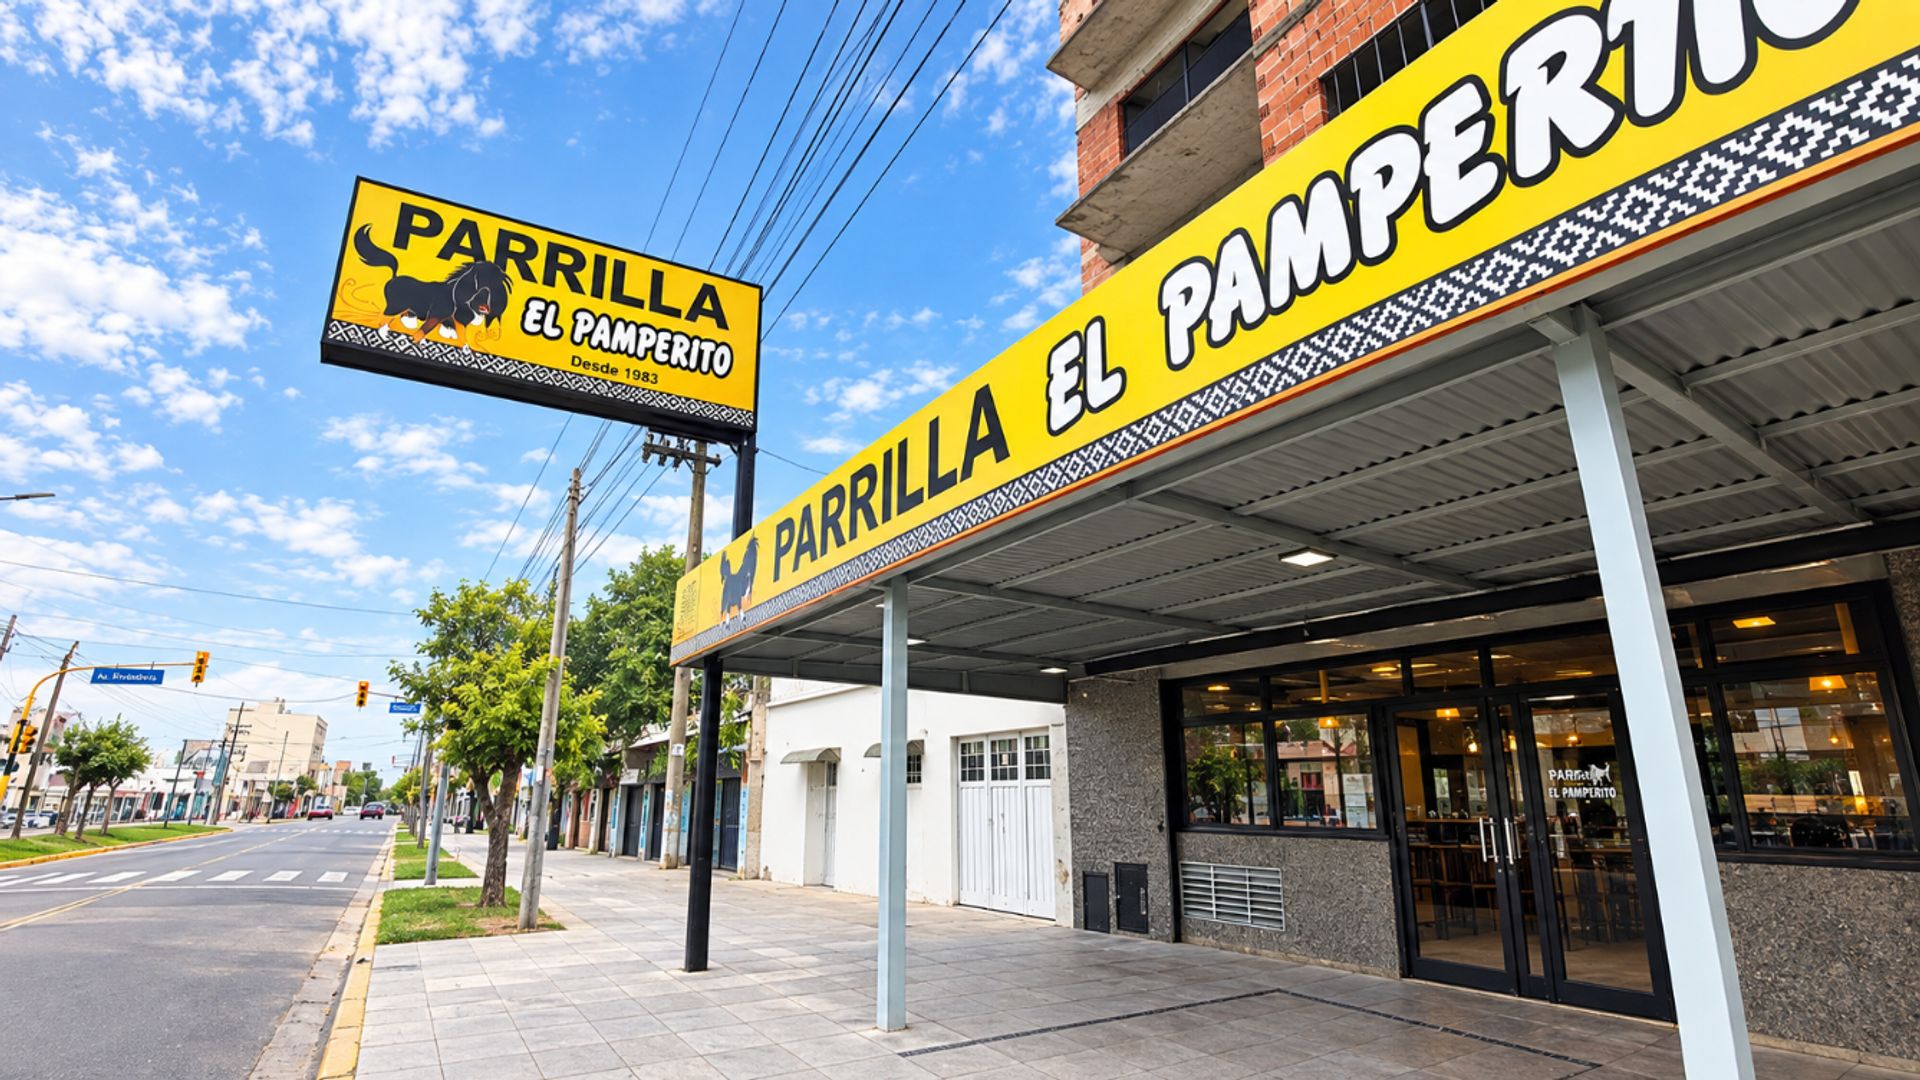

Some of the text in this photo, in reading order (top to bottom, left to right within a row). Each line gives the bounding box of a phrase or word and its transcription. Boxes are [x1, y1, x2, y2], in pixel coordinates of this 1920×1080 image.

[393, 202, 730, 330] PARRILLA
[773, 0, 1863, 582] PARRILLA EL PAMPER
[521, 297, 734, 379] EL PAMPERITO
[570, 355, 660, 385] Desde 1983
[1548, 787, 1560, 798] EL
